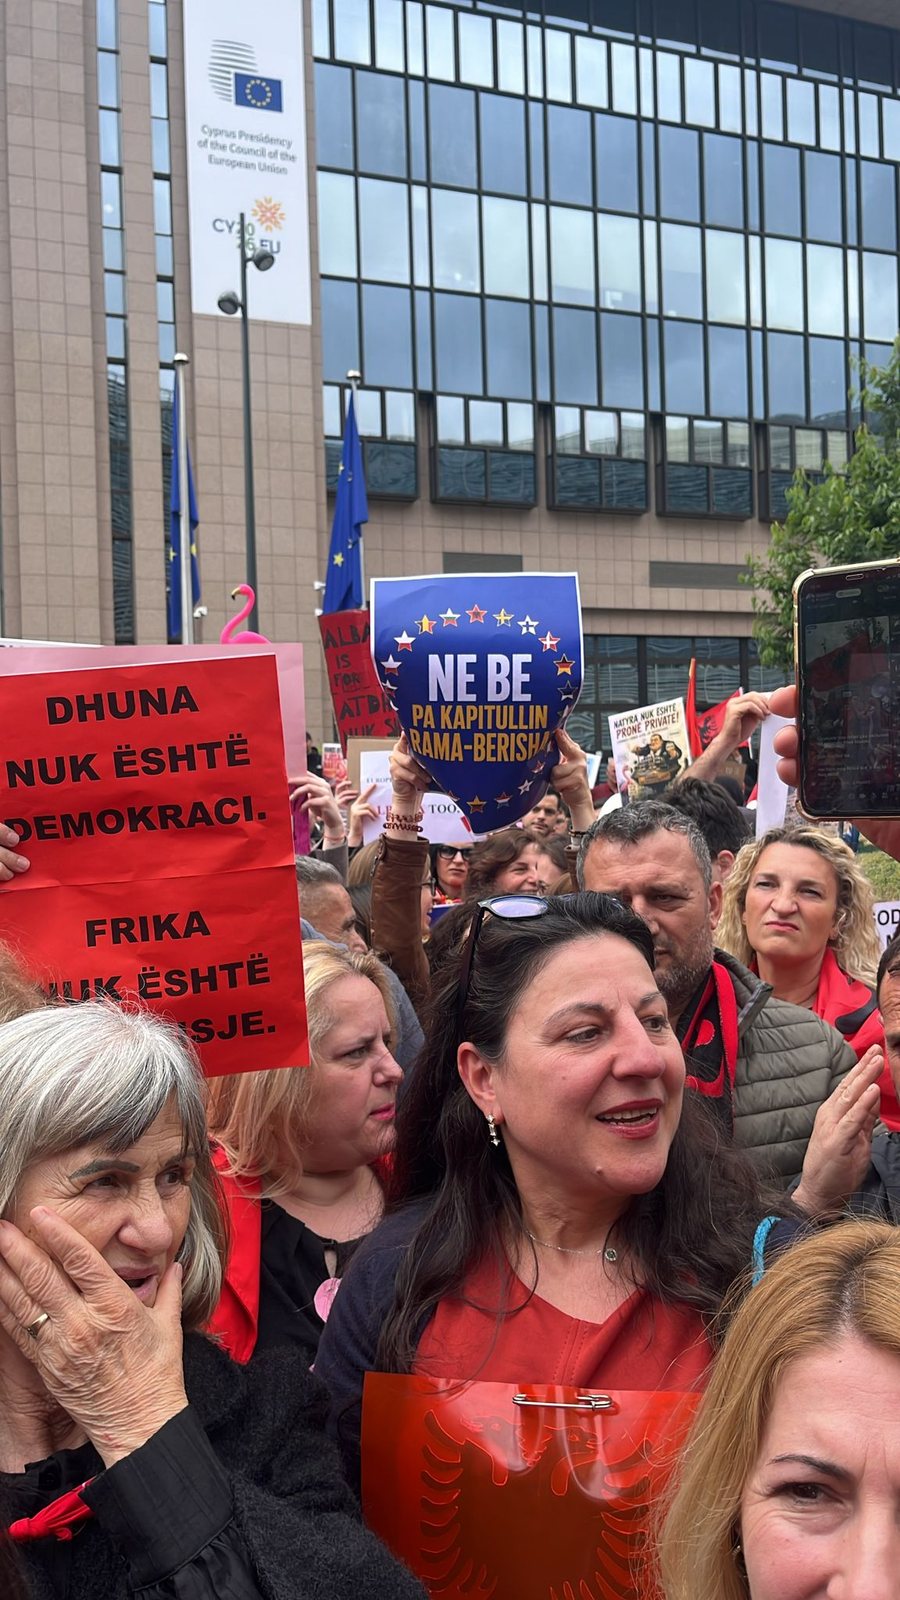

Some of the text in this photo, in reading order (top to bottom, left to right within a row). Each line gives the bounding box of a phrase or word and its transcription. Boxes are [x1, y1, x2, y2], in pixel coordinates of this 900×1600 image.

[201, 124, 292, 150] Cyprus Presidency
[197, 139, 296, 162] of the Council of the
[208, 154, 288, 175] European Union
[336, 654, 351, 669] IS
[428, 653, 532, 702] NE BE
[46, 685, 199, 725] DHUNA
[412, 704, 547, 730] PA KAPITULLIN
[613, 715, 638, 729] NATYRA
[640, 709, 655, 721] NUK
[644, 711, 680, 731] PRIVATE!
[6, 733, 251, 788] NUK ËSHTË
[4, 796, 266, 842] DEMOKRACI.
[428, 803, 460, 814] TOO.
[85, 910, 211, 947] FRIKA
[138, 952, 271, 1000] ËSHTË
